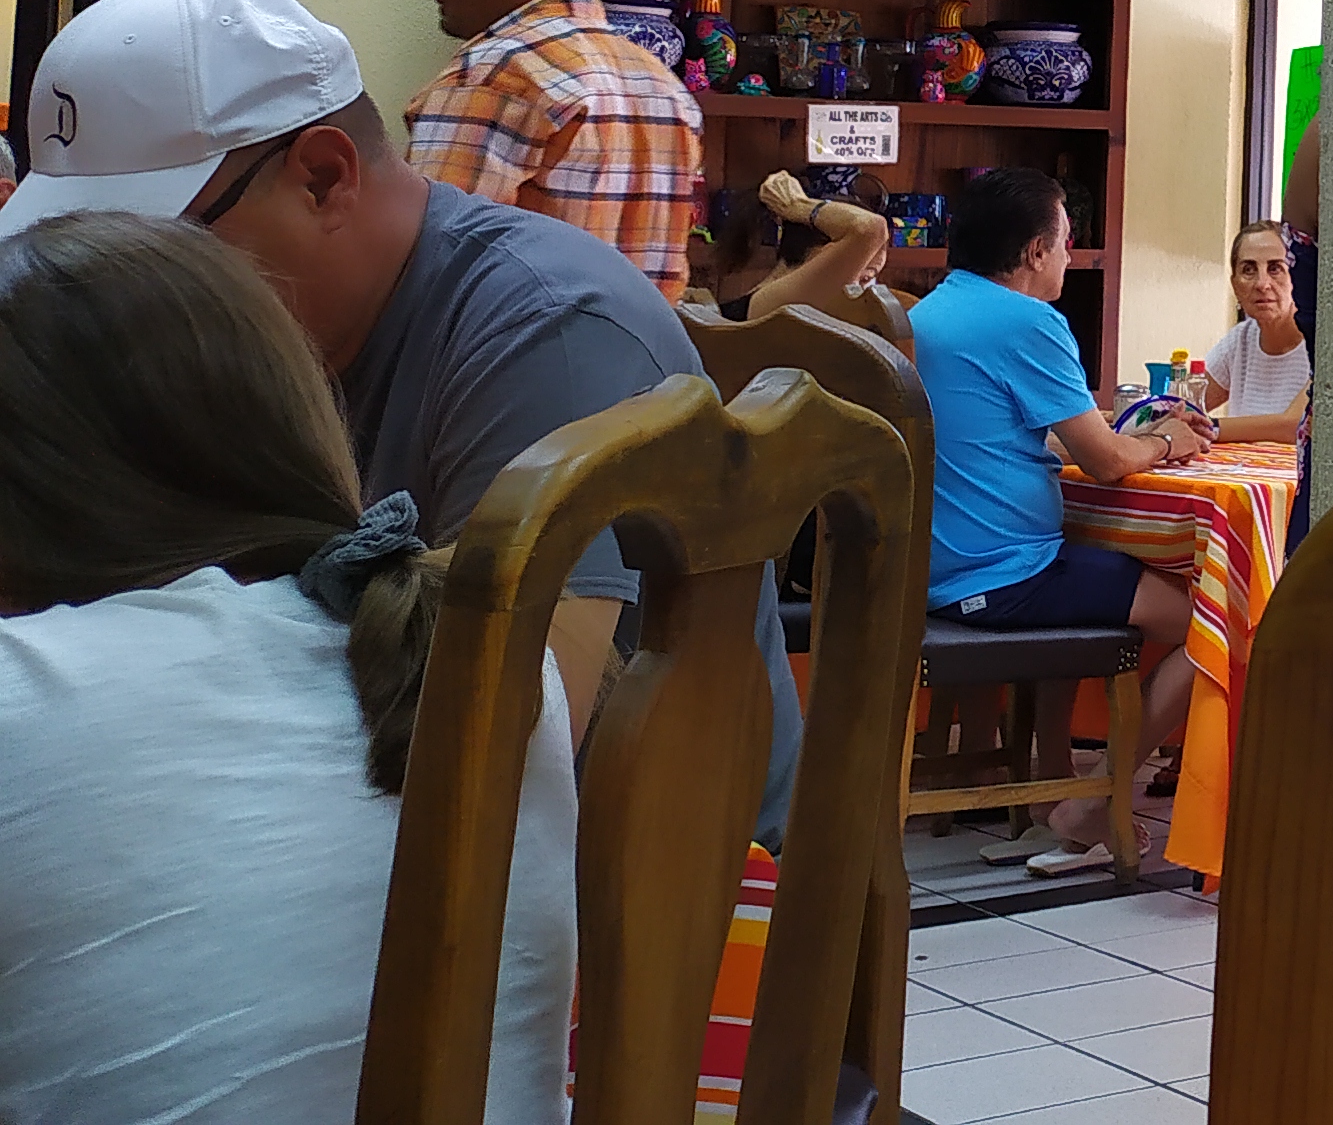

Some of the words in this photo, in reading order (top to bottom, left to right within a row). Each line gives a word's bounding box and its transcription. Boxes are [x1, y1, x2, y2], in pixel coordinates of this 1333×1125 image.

[829, 111, 842, 122] ALL
[844, 111, 858, 123] THE
[860, 111, 878, 123] ARTS
[849, 125, 856, 134] &
[830, 135, 876, 145] CRAFTS
[834, 146, 854, 157] 40%
